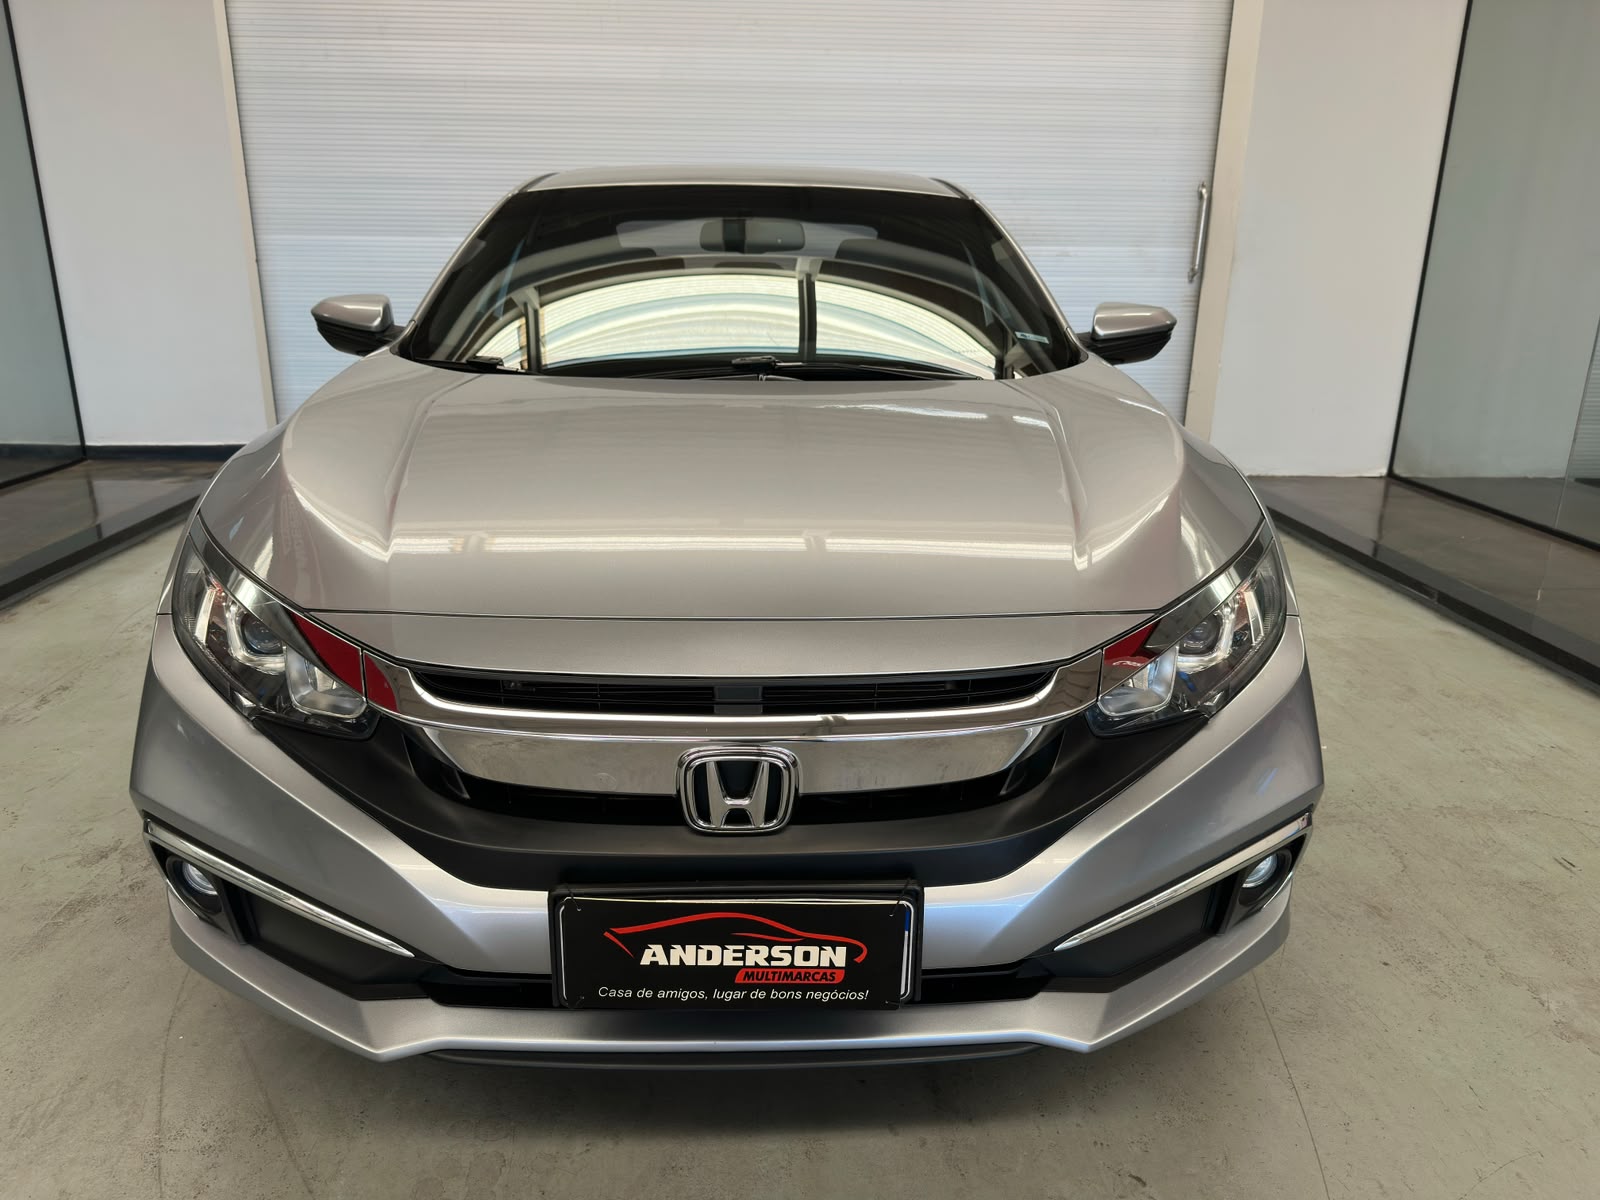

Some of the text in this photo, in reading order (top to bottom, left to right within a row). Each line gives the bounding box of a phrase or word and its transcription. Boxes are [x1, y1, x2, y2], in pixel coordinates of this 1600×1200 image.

[640, 944, 847, 967] ANDERSON
[743, 970, 836, 982] MULTIMARCAS
[598, 986, 869, 1002] Casa de amigos, lugar de bons negócios!
